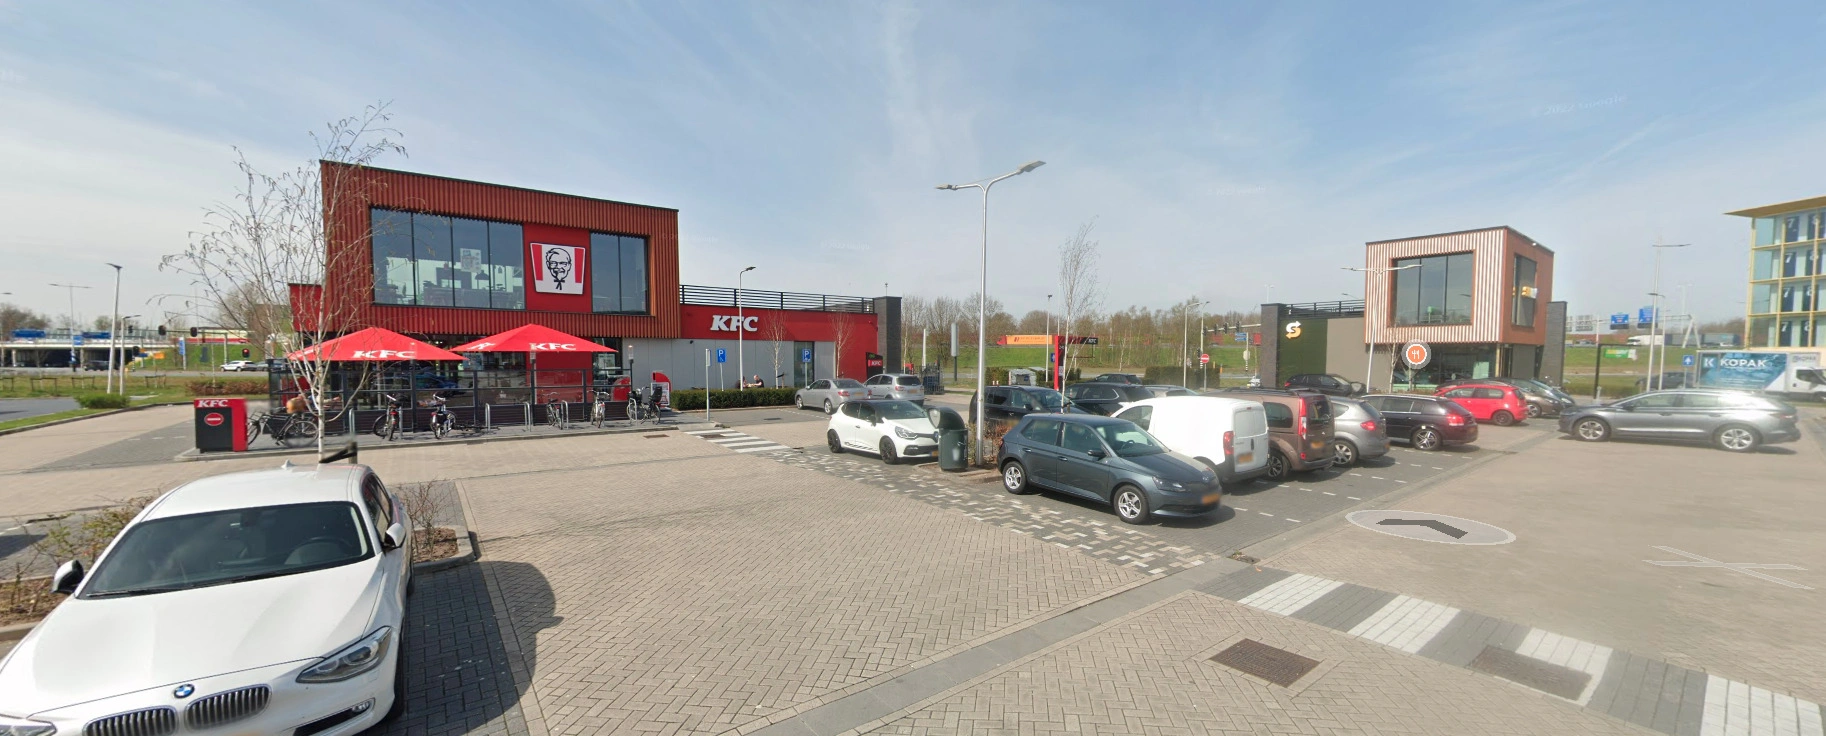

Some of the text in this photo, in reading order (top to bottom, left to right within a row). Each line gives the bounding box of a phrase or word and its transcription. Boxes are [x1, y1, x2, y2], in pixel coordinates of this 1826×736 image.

[710, 315, 759, 332] KFC
[530, 342, 577, 351] KFC
[353, 349, 417, 359] KFC
[1720, 358, 1768, 368] KOPAK
[196, 399, 229, 408] KFC
